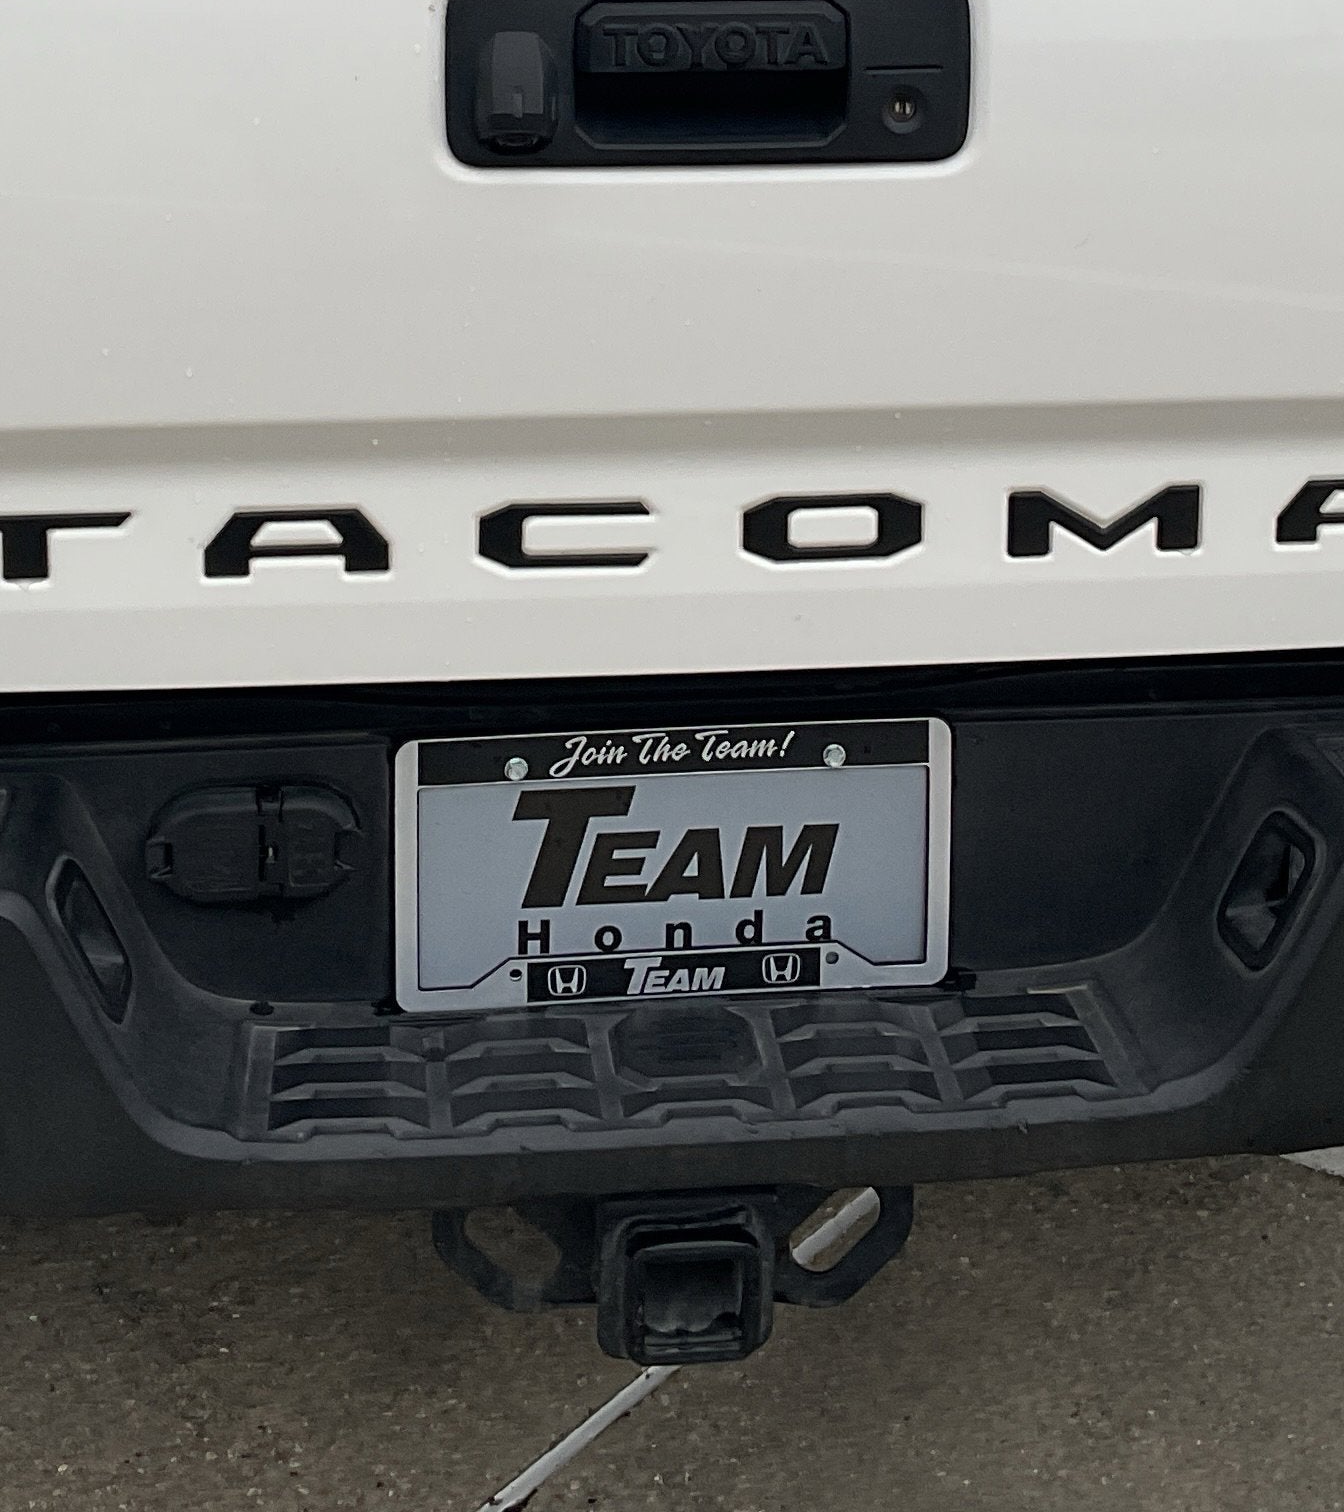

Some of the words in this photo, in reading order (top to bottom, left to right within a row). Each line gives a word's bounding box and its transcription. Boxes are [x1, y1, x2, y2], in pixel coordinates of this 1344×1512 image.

[600, 20, 829, 70] TOYOTA
[549, 735, 629, 778] Join
[631, 733, 692, 766] The
[695, 730, 796, 763] Team!
[511, 784, 841, 909] TEAM
[517, 909, 833, 955] Honda
[622, 956, 727, 995] TEAM
